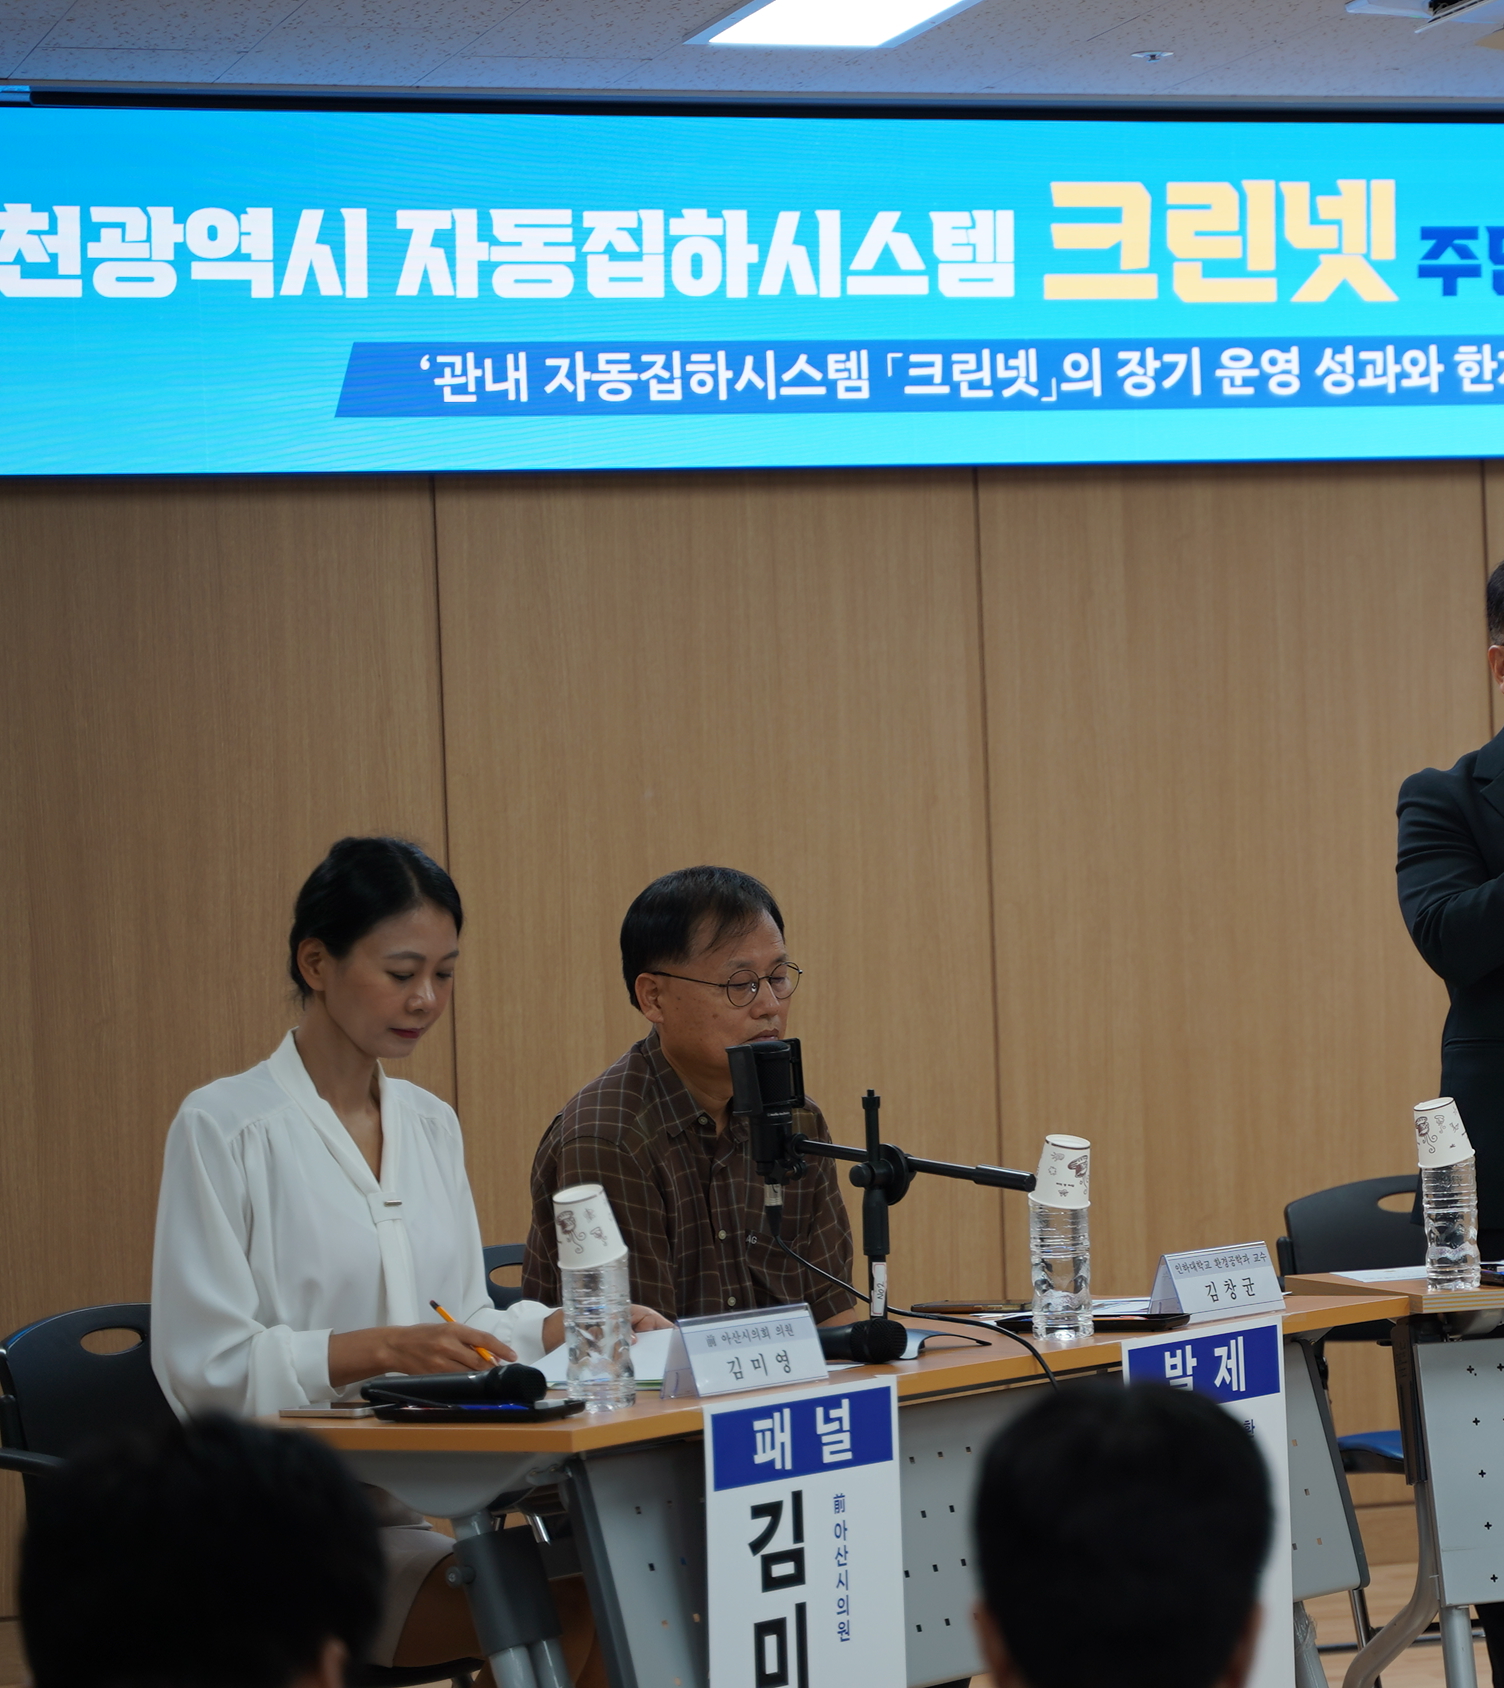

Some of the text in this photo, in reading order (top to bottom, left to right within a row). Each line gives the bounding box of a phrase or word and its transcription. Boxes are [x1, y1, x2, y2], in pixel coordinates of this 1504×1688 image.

[0, 203, 369, 299] 천광역시
[395, 208, 1015, 299] 자동집하시스템
[1043, 179, 1399, 303] 크린넷
[544, 349, 871, 402] 자동집하시스템
[1116, 346, 1202, 397] 장기
[1215, 345, 1302, 396] 운영
[1315, 344, 1446, 395] 성과와
[1174, 1251, 1268, 1275] 인하대학교 환경공학과 교수
[721, 1326, 771, 1344] 아산시의회
[775, 1323, 795, 1338] 의원
[833, 1519, 851, 1643] 아산시의원
